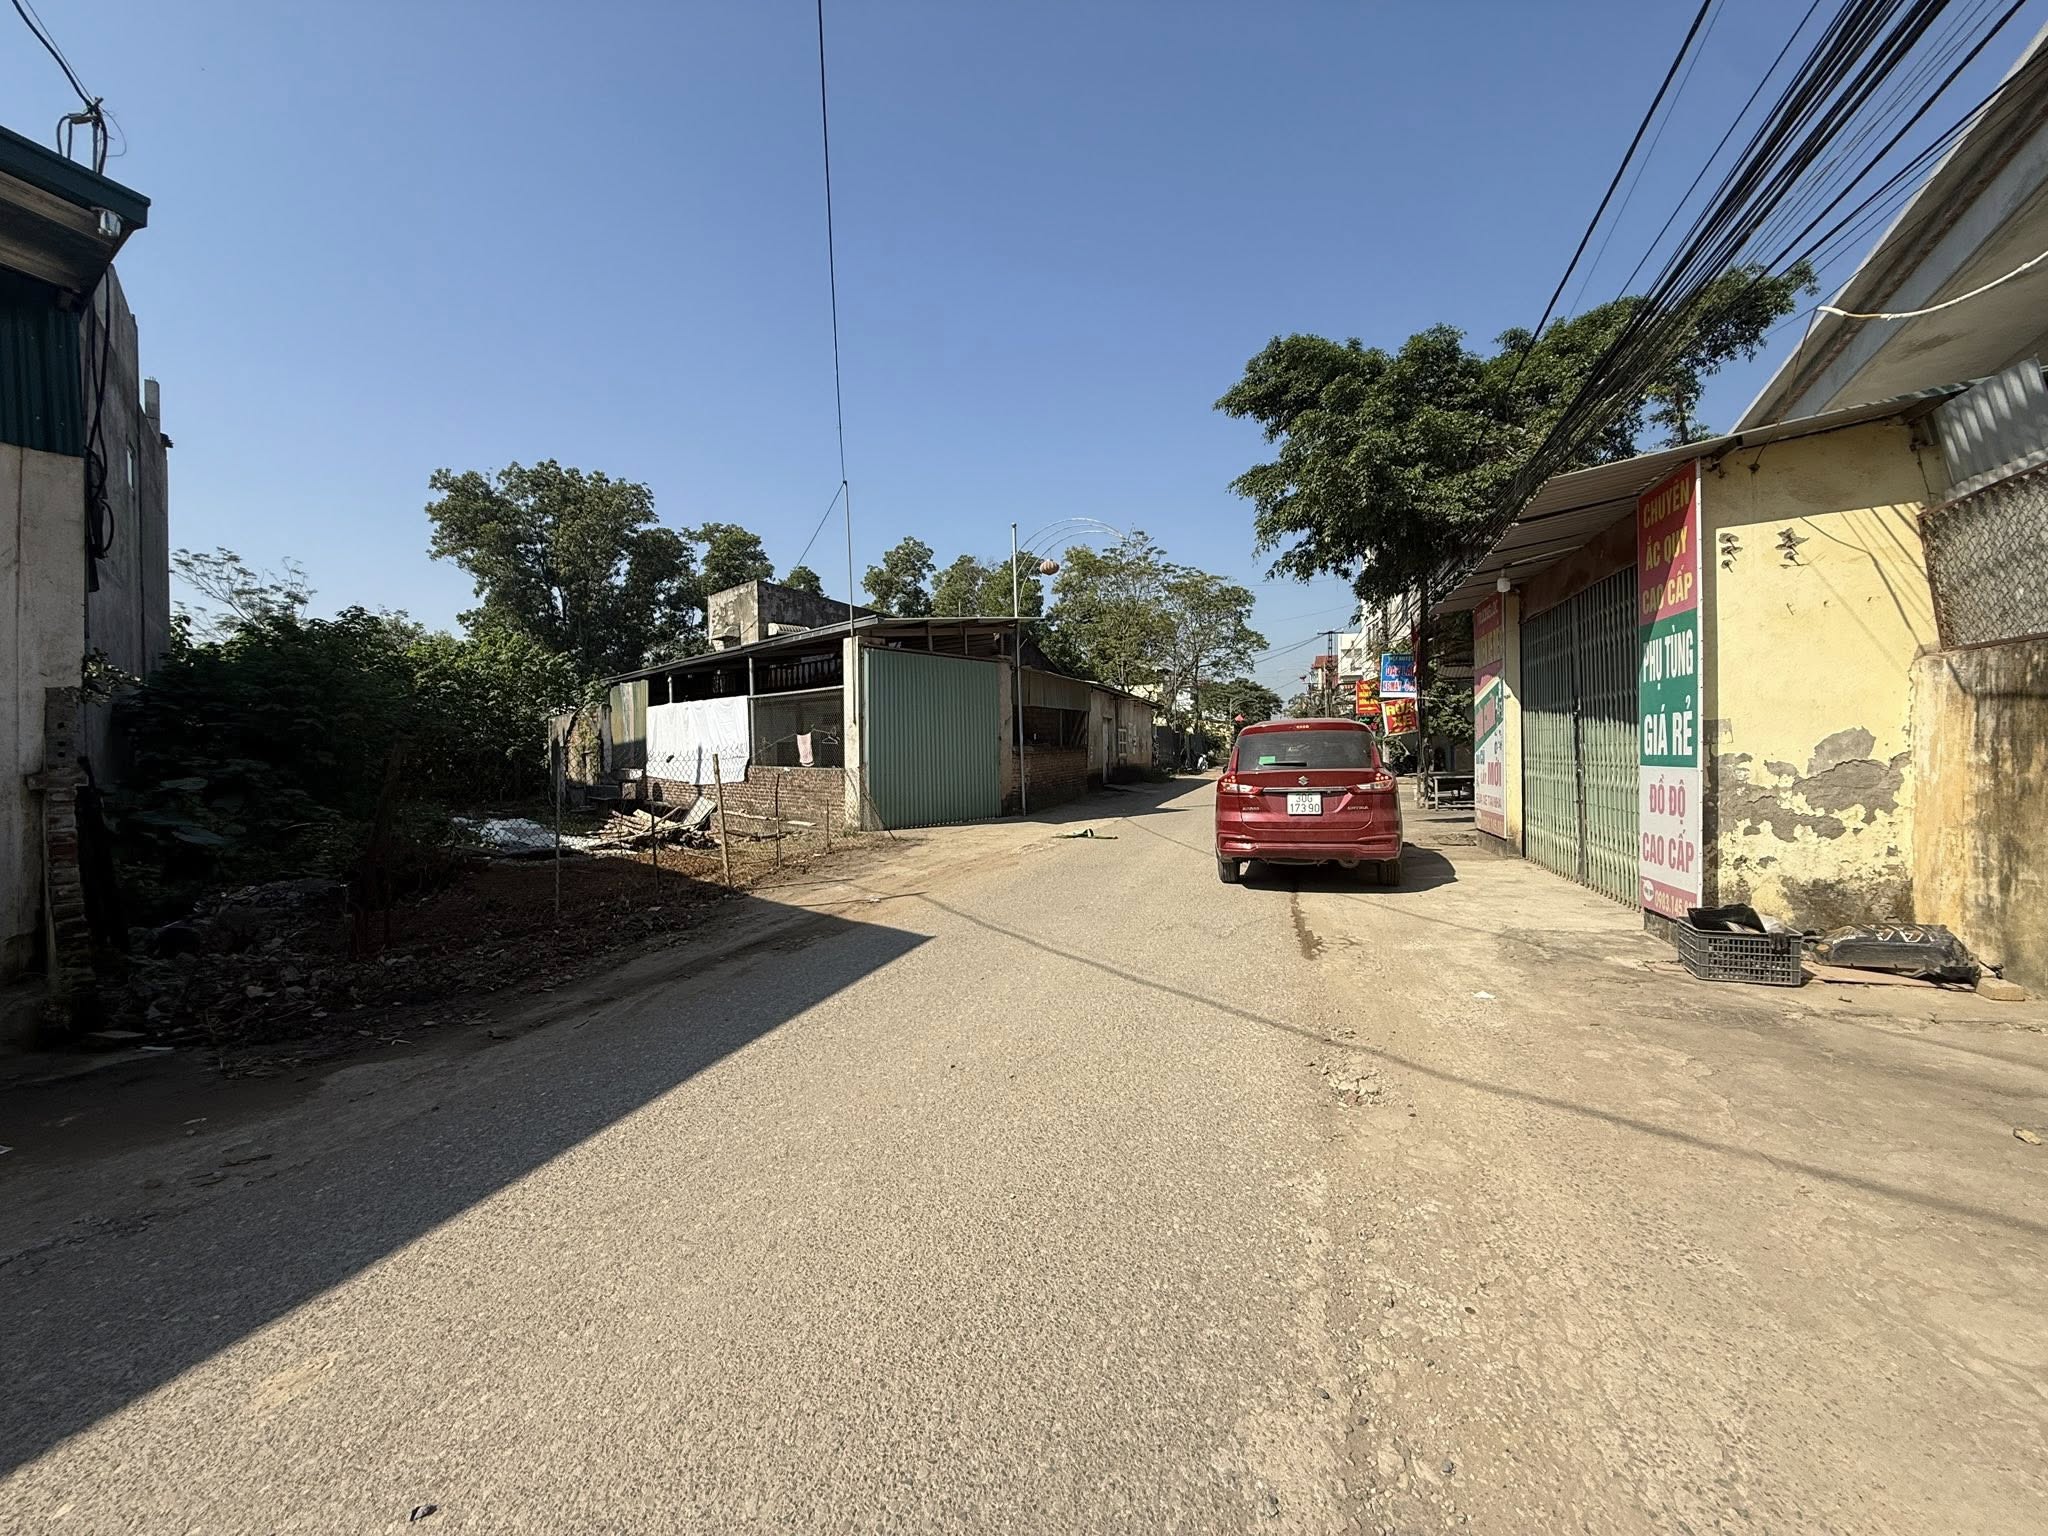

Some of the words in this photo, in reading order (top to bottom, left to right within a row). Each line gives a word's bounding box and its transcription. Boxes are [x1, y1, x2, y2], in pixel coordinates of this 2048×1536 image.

[1643, 477, 1690, 529] CHUYÊN
[1645, 536, 1660, 571] ẮC
[1663, 525, 1688, 565] QUY
[1642, 583, 1665, 616] CAO
[1667, 564, 1693, 606] CẤP
[1643, 638, 1662, 690] PHỤ
[1664, 624, 1693, 679] TÙNG
[1392, 715, 1413, 727] XE
[1643, 704, 1668, 756] GIÁ
[1672, 695, 1693, 756] RẺ
[1295, 793, 1313, 802] 30G
[1668, 779, 1685, 825] ĐỘ
[1642, 832, 1665, 866] CAO
[1668, 829, 1695, 873] CẤP
